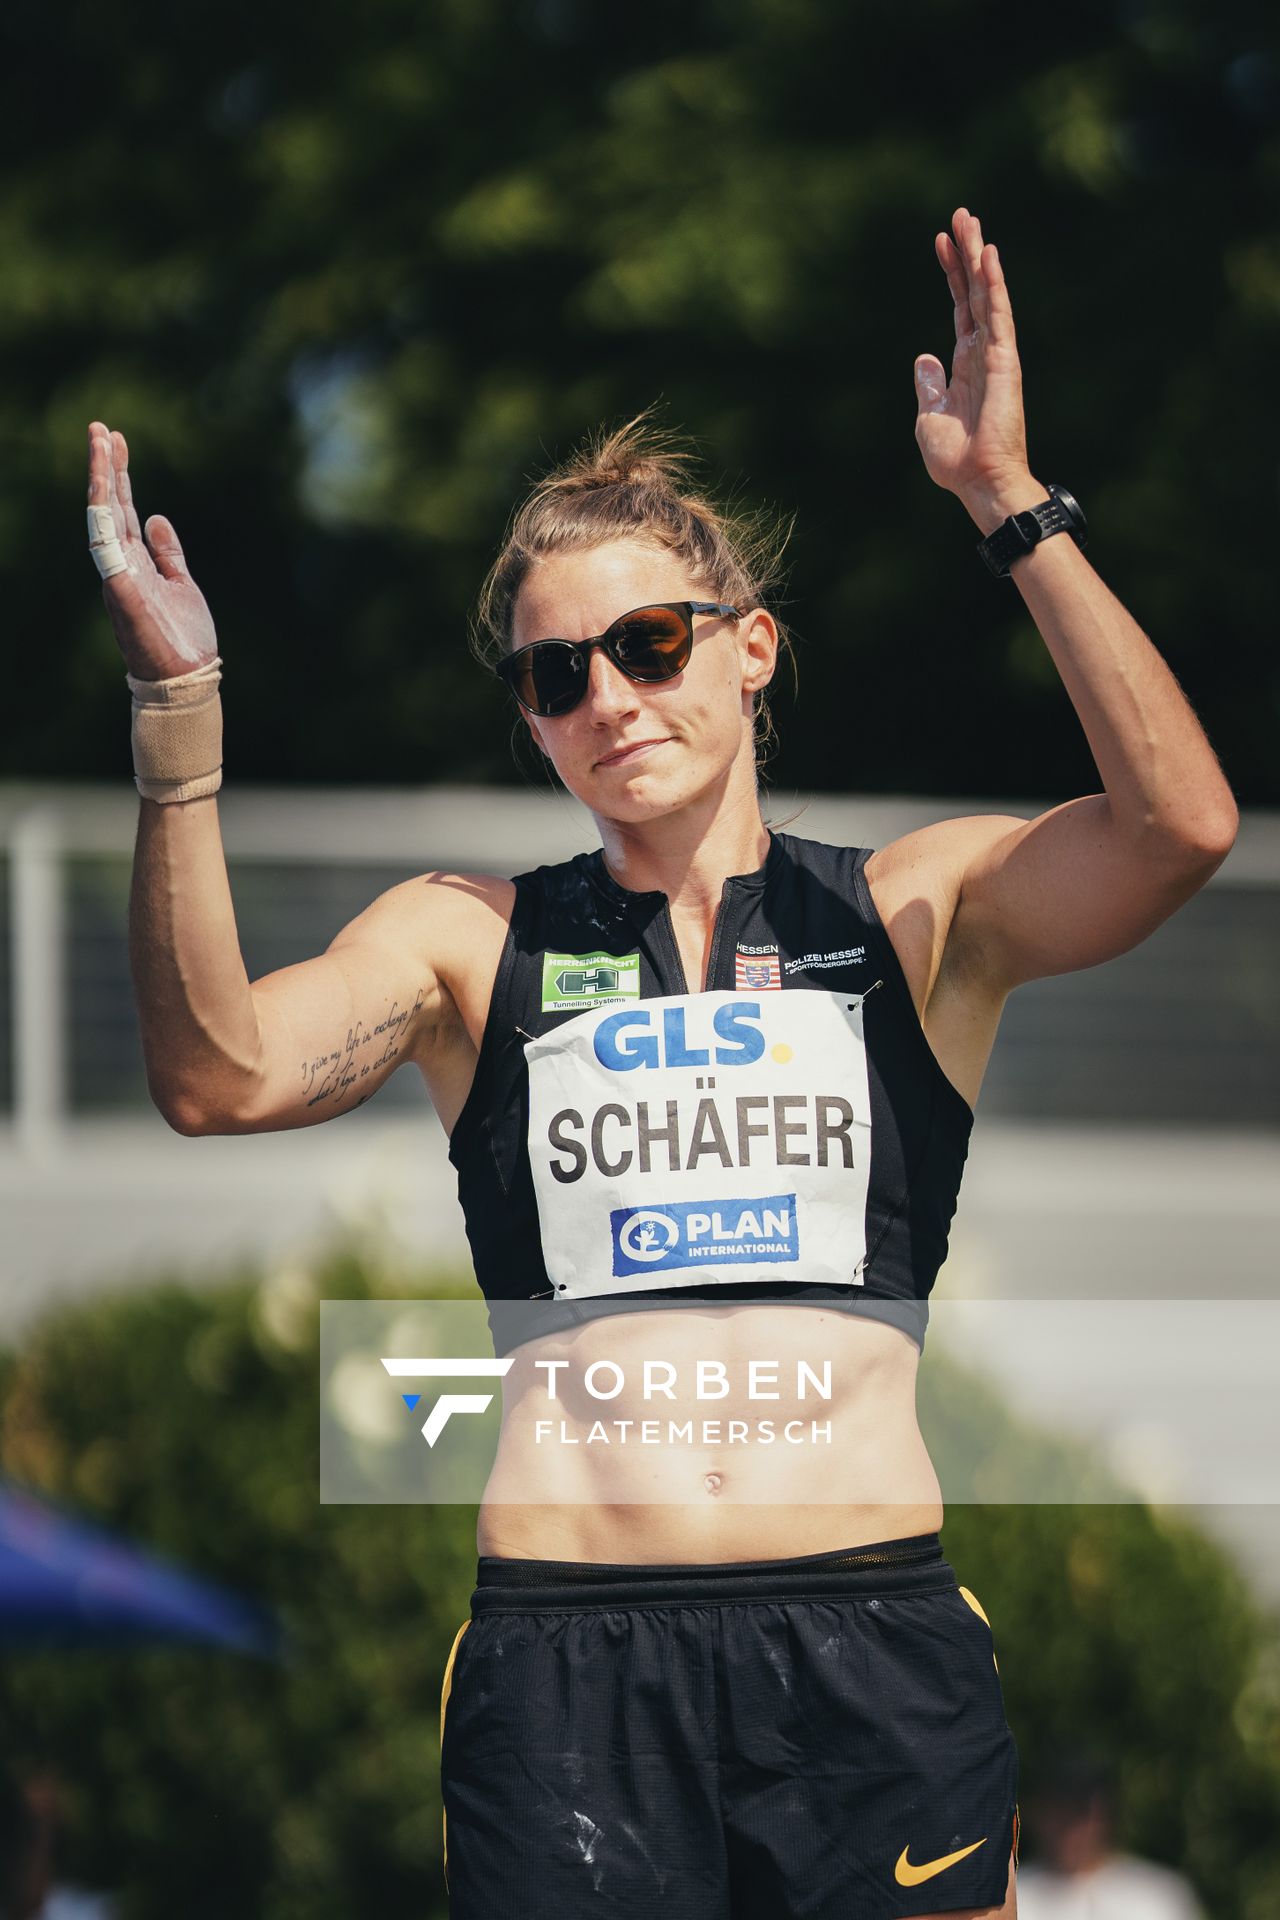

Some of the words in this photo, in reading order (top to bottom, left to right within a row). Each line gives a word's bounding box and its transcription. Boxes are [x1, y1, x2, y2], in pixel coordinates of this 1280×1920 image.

[736, 942, 779, 955] HESSEN
[784, 953, 823, 970] POLIZEI
[824, 945, 865, 962] HESSEN
[549, 956, 636, 968] HERRENKNECHT
[553, 999, 592, 1009] Tunnelling
[593, 997, 626, 1006] Systems
[302, 1056, 328, 1095] give
[330, 1050, 342, 1074] my
[340, 1021, 362, 1074] life
[363, 1031, 372, 1044] in
[374, 1002, 407, 1040] exchange
[400, 989, 424, 1036] for
[335, 1062, 357, 1103] hope
[361, 1064, 370, 1077] to
[547, 1077, 855, 1184] SCHÄFER
[686, 1210, 791, 1242] PLAN
[688, 1243, 791, 1258] INTERNATIONAL
